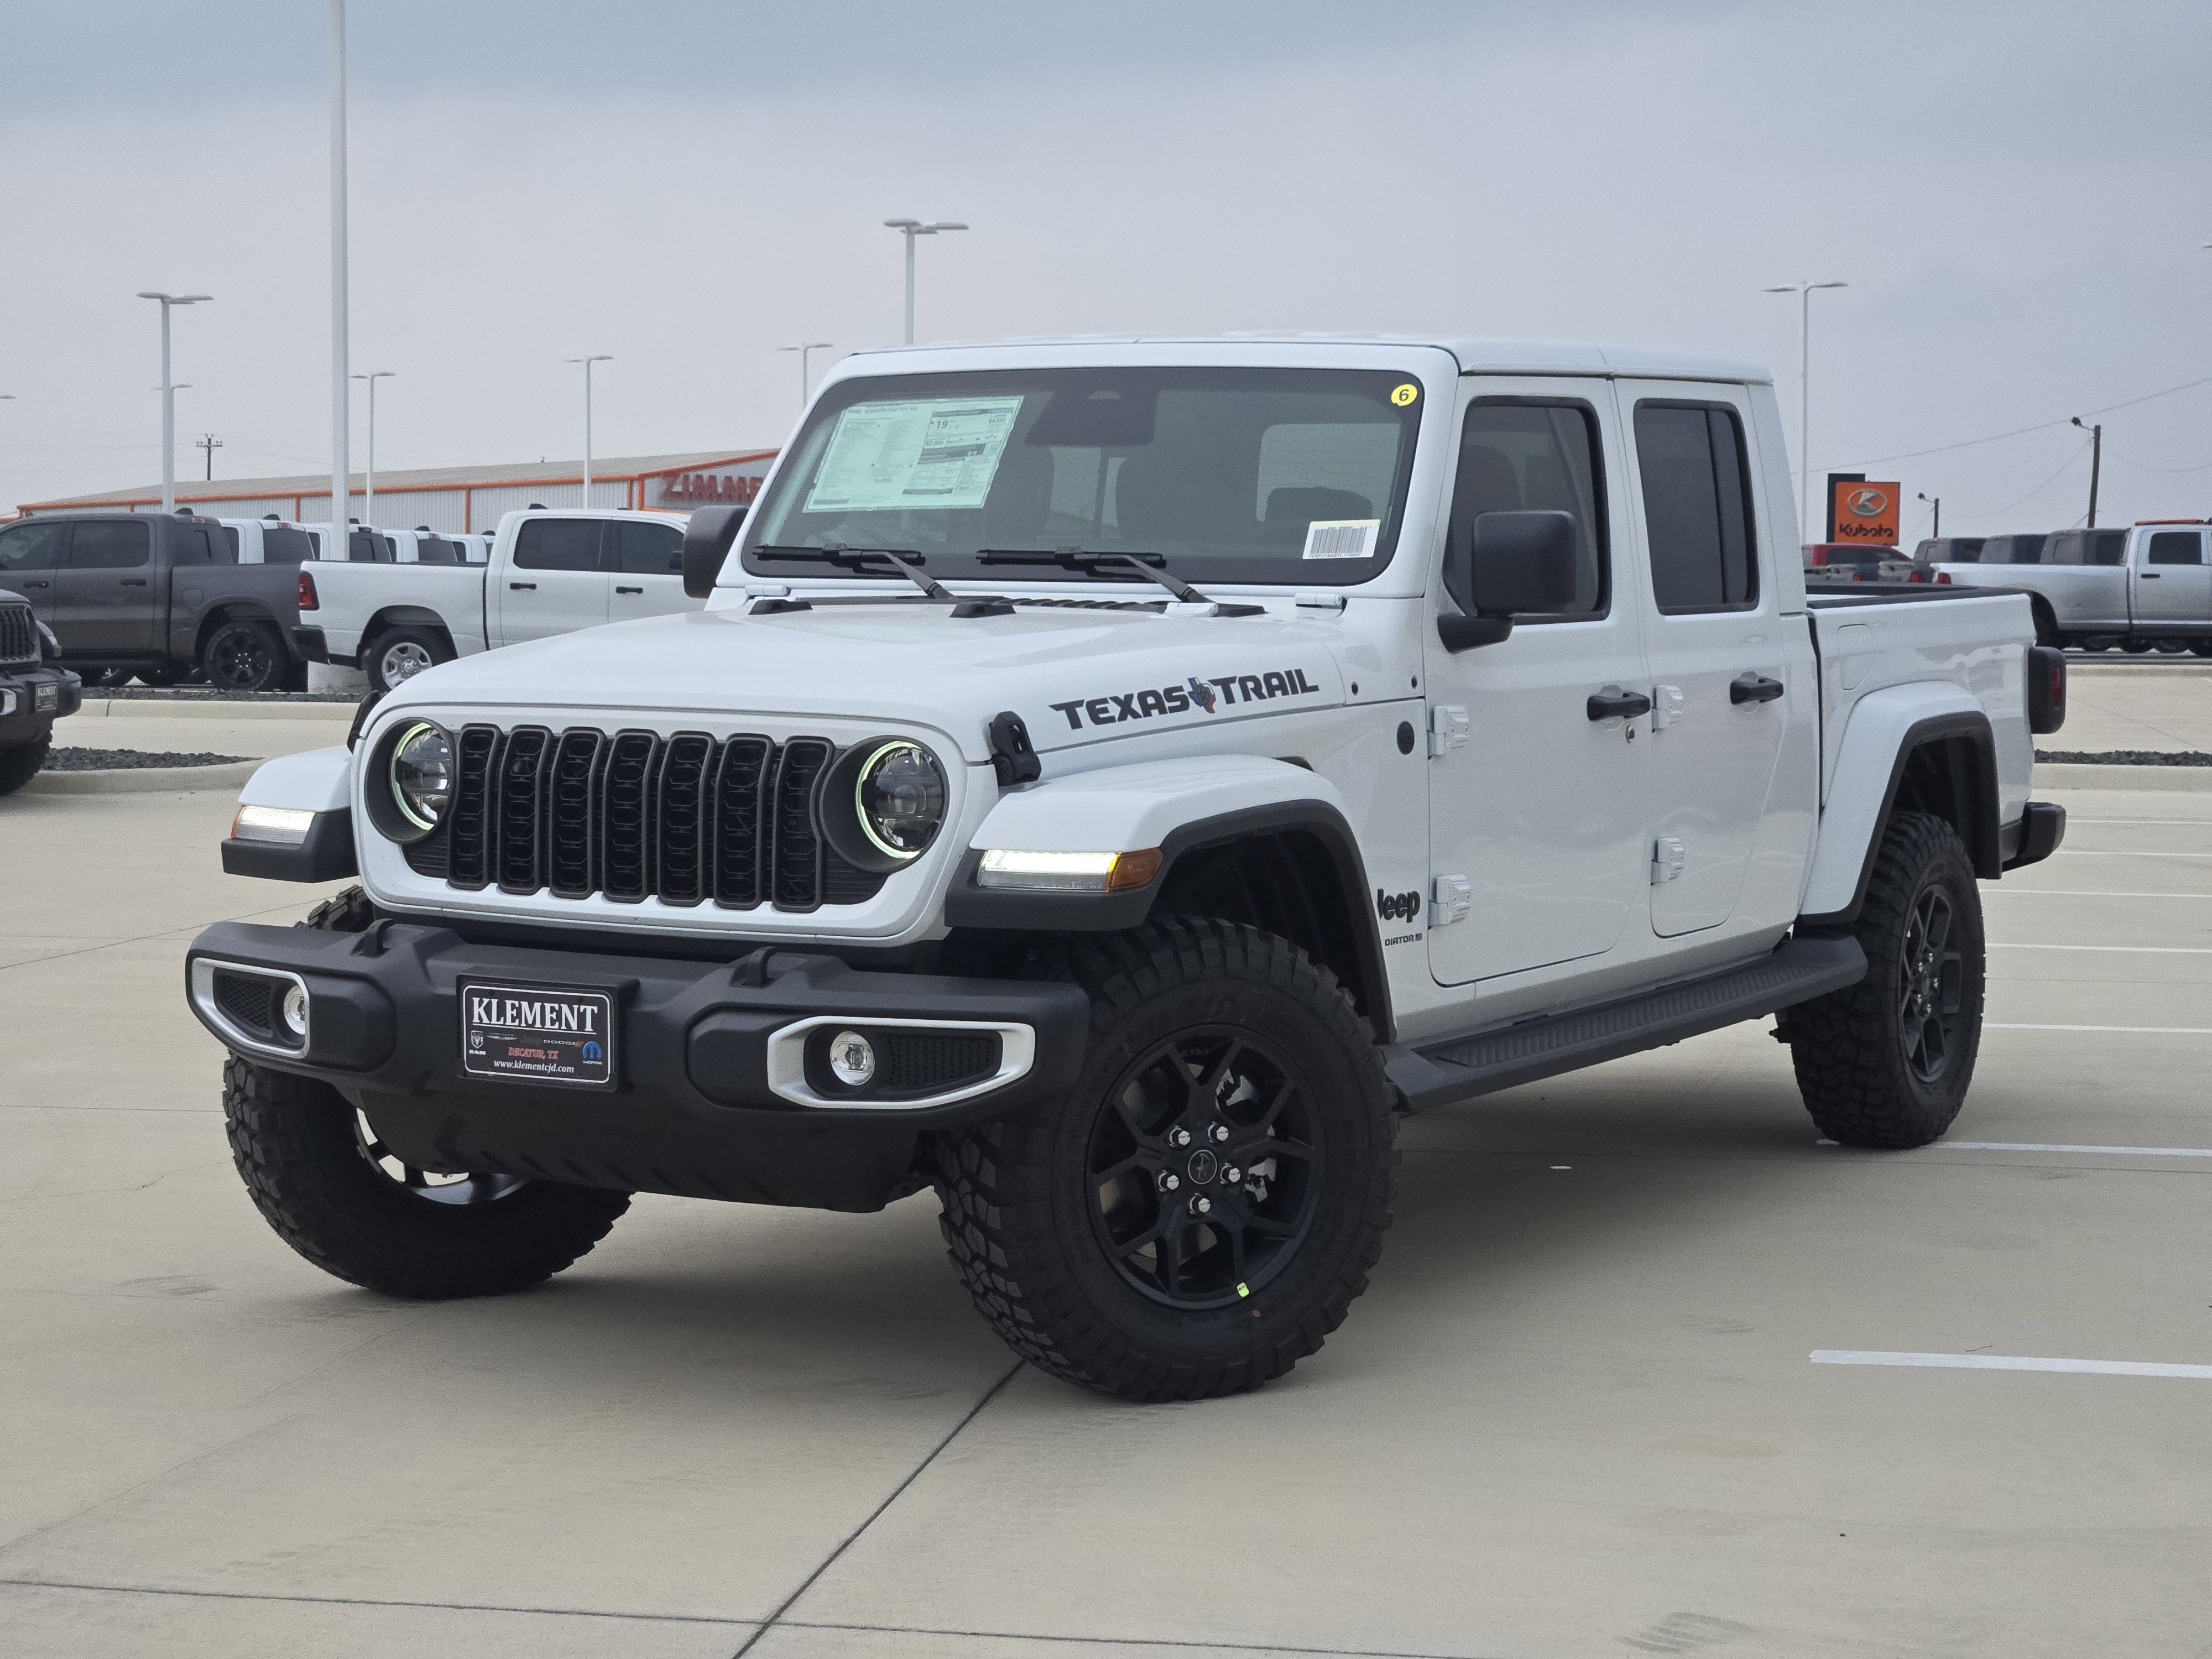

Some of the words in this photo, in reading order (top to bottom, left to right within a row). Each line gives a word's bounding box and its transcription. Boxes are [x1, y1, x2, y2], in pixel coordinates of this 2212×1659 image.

[1399, 389, 1409, 402] 6
[936, 420, 948, 429] 19
[1839, 523, 1893, 538] Kubota
[1048, 685, 1190, 730] TEXAS
[1208, 669, 1319, 705] TRAIL
[1385, 935, 1415, 947] DIATOR
[472, 997, 598, 1032] KLEMENT
[508, 1047, 546, 1060] DECATUR,
[547, 1050, 559, 1060] TX
[494, 1060, 575, 1074] www.klementcjd.com
